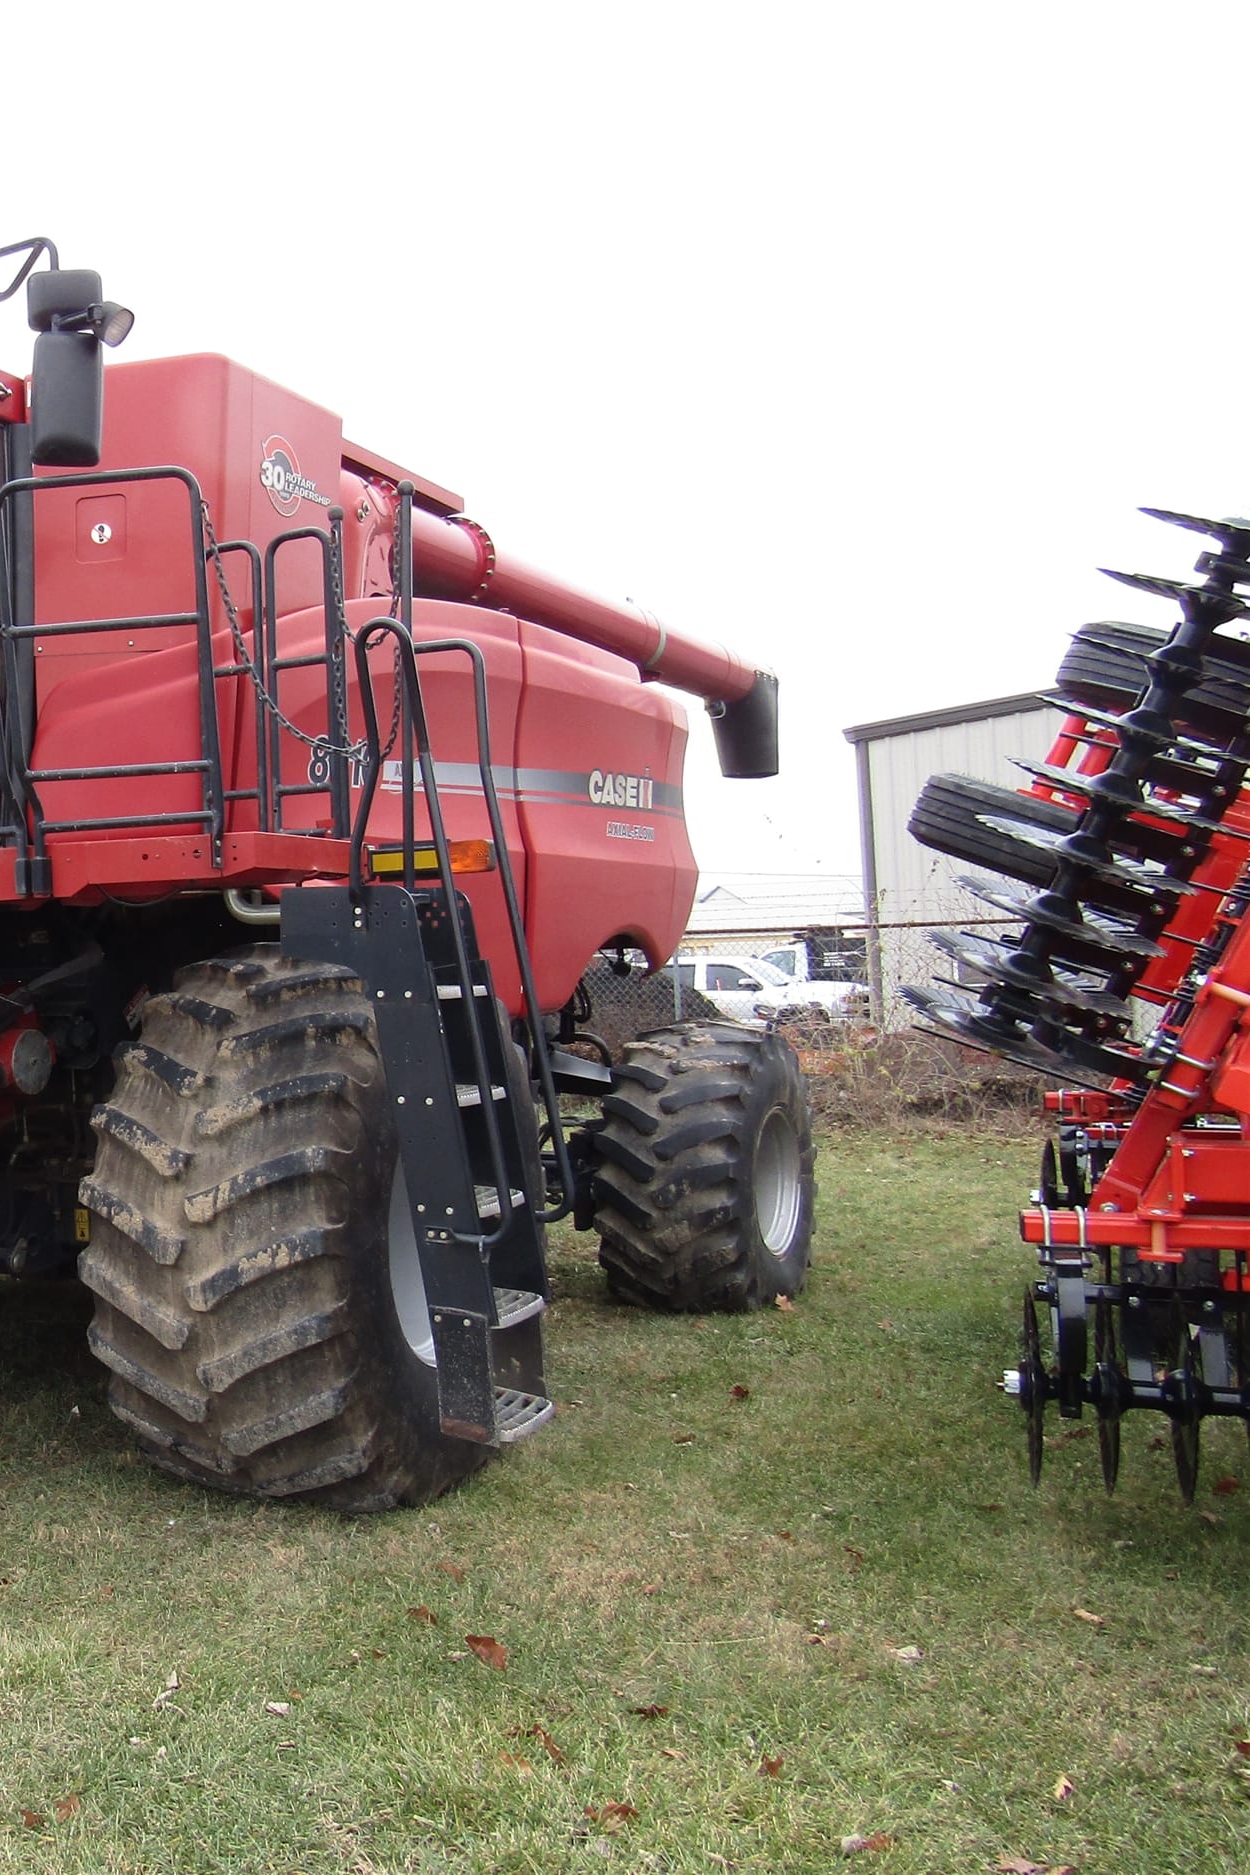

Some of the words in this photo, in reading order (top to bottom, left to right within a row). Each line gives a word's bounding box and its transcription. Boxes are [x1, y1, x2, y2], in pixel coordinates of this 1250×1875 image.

[260, 460, 285, 491] 30
[285, 472, 317, 491] ROTARY
[284, 481, 332, 506] LEADERSHIP
